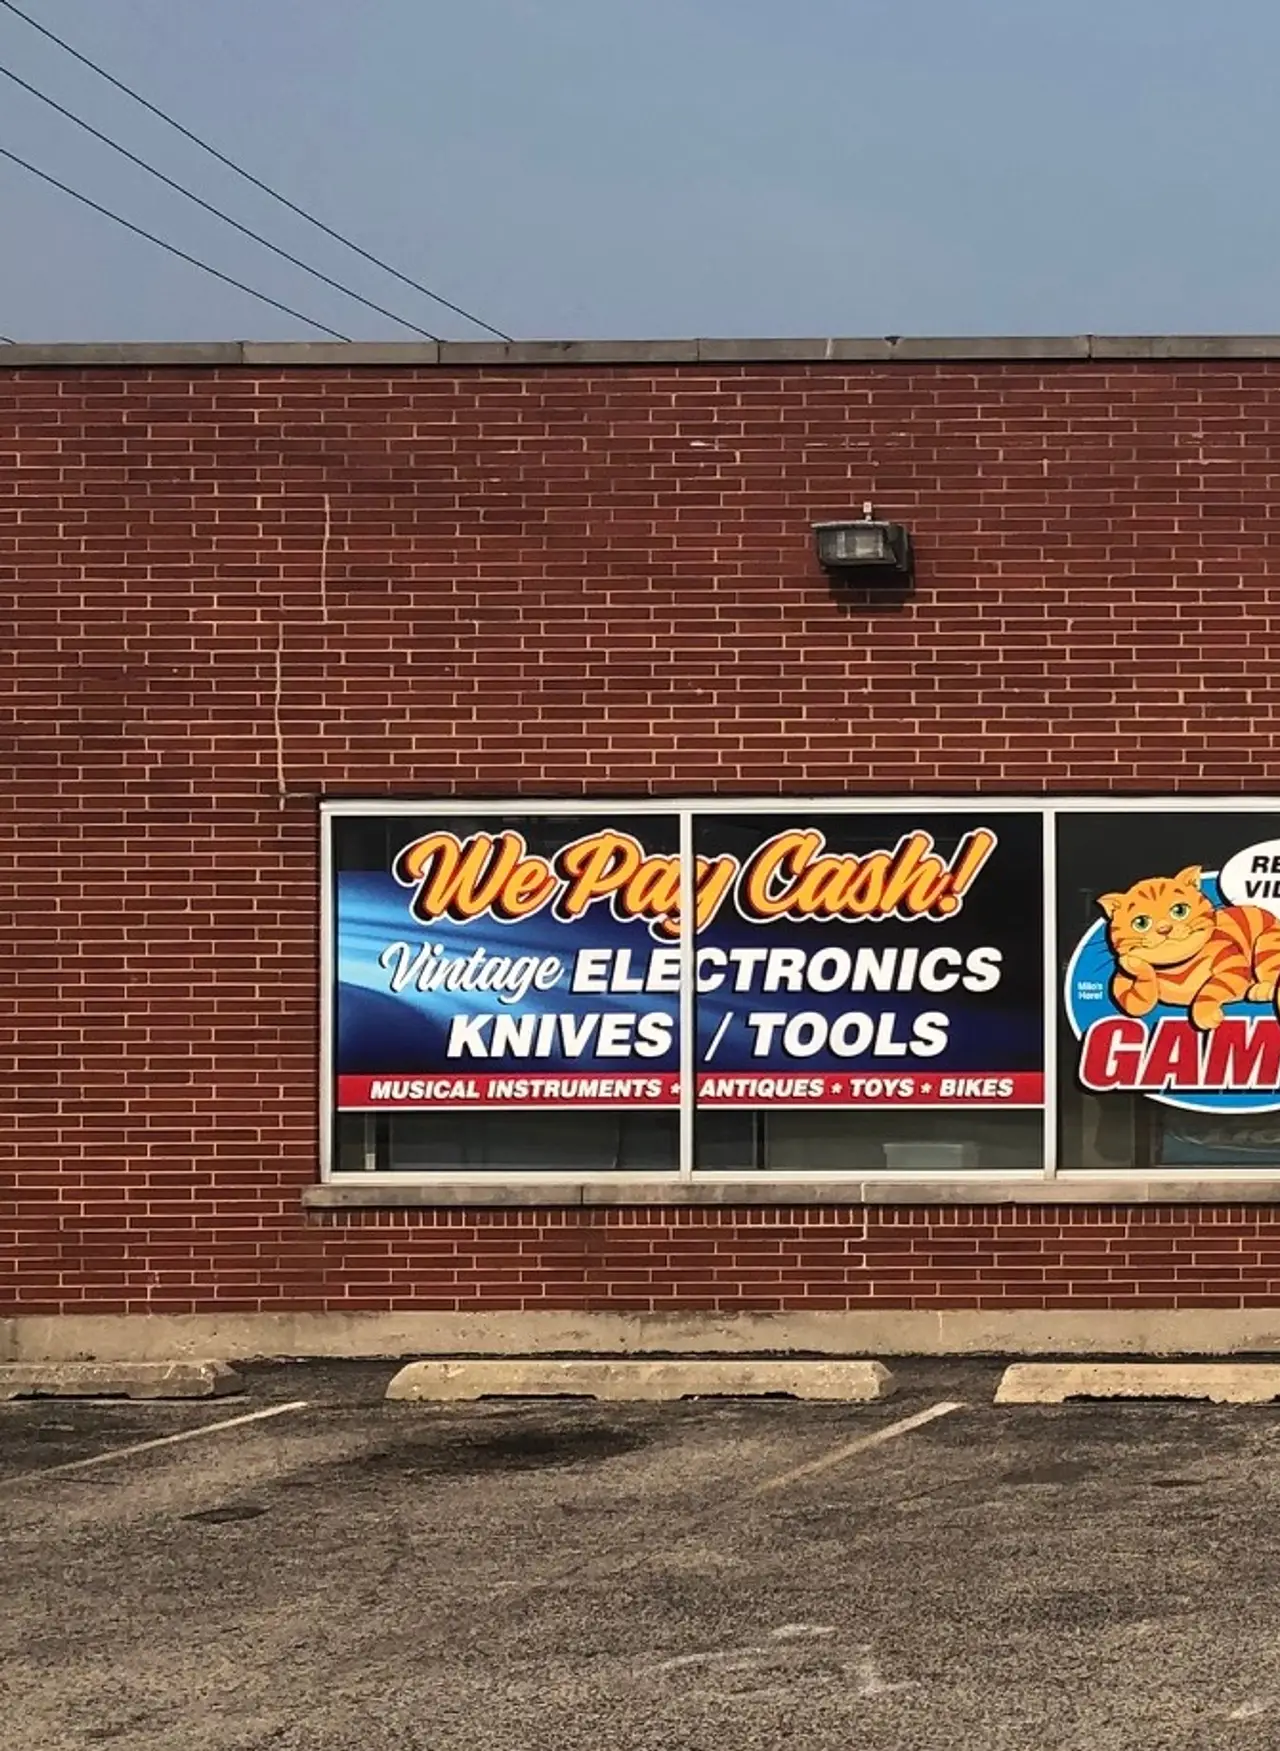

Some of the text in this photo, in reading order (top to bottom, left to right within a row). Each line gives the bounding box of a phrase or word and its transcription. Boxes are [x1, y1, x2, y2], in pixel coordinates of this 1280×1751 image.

[394, 827, 997, 944] We Pay Cash!
[379, 941, 1004, 1004] Vintage ELECTRONICS
[446, 1011, 674, 1058] KNIVES
[748, 1010, 951, 1058] TOOLS
[370, 1077, 1014, 1100] MUSICAL INSTRUMENTS ANTIQUES TOYS BIKES
